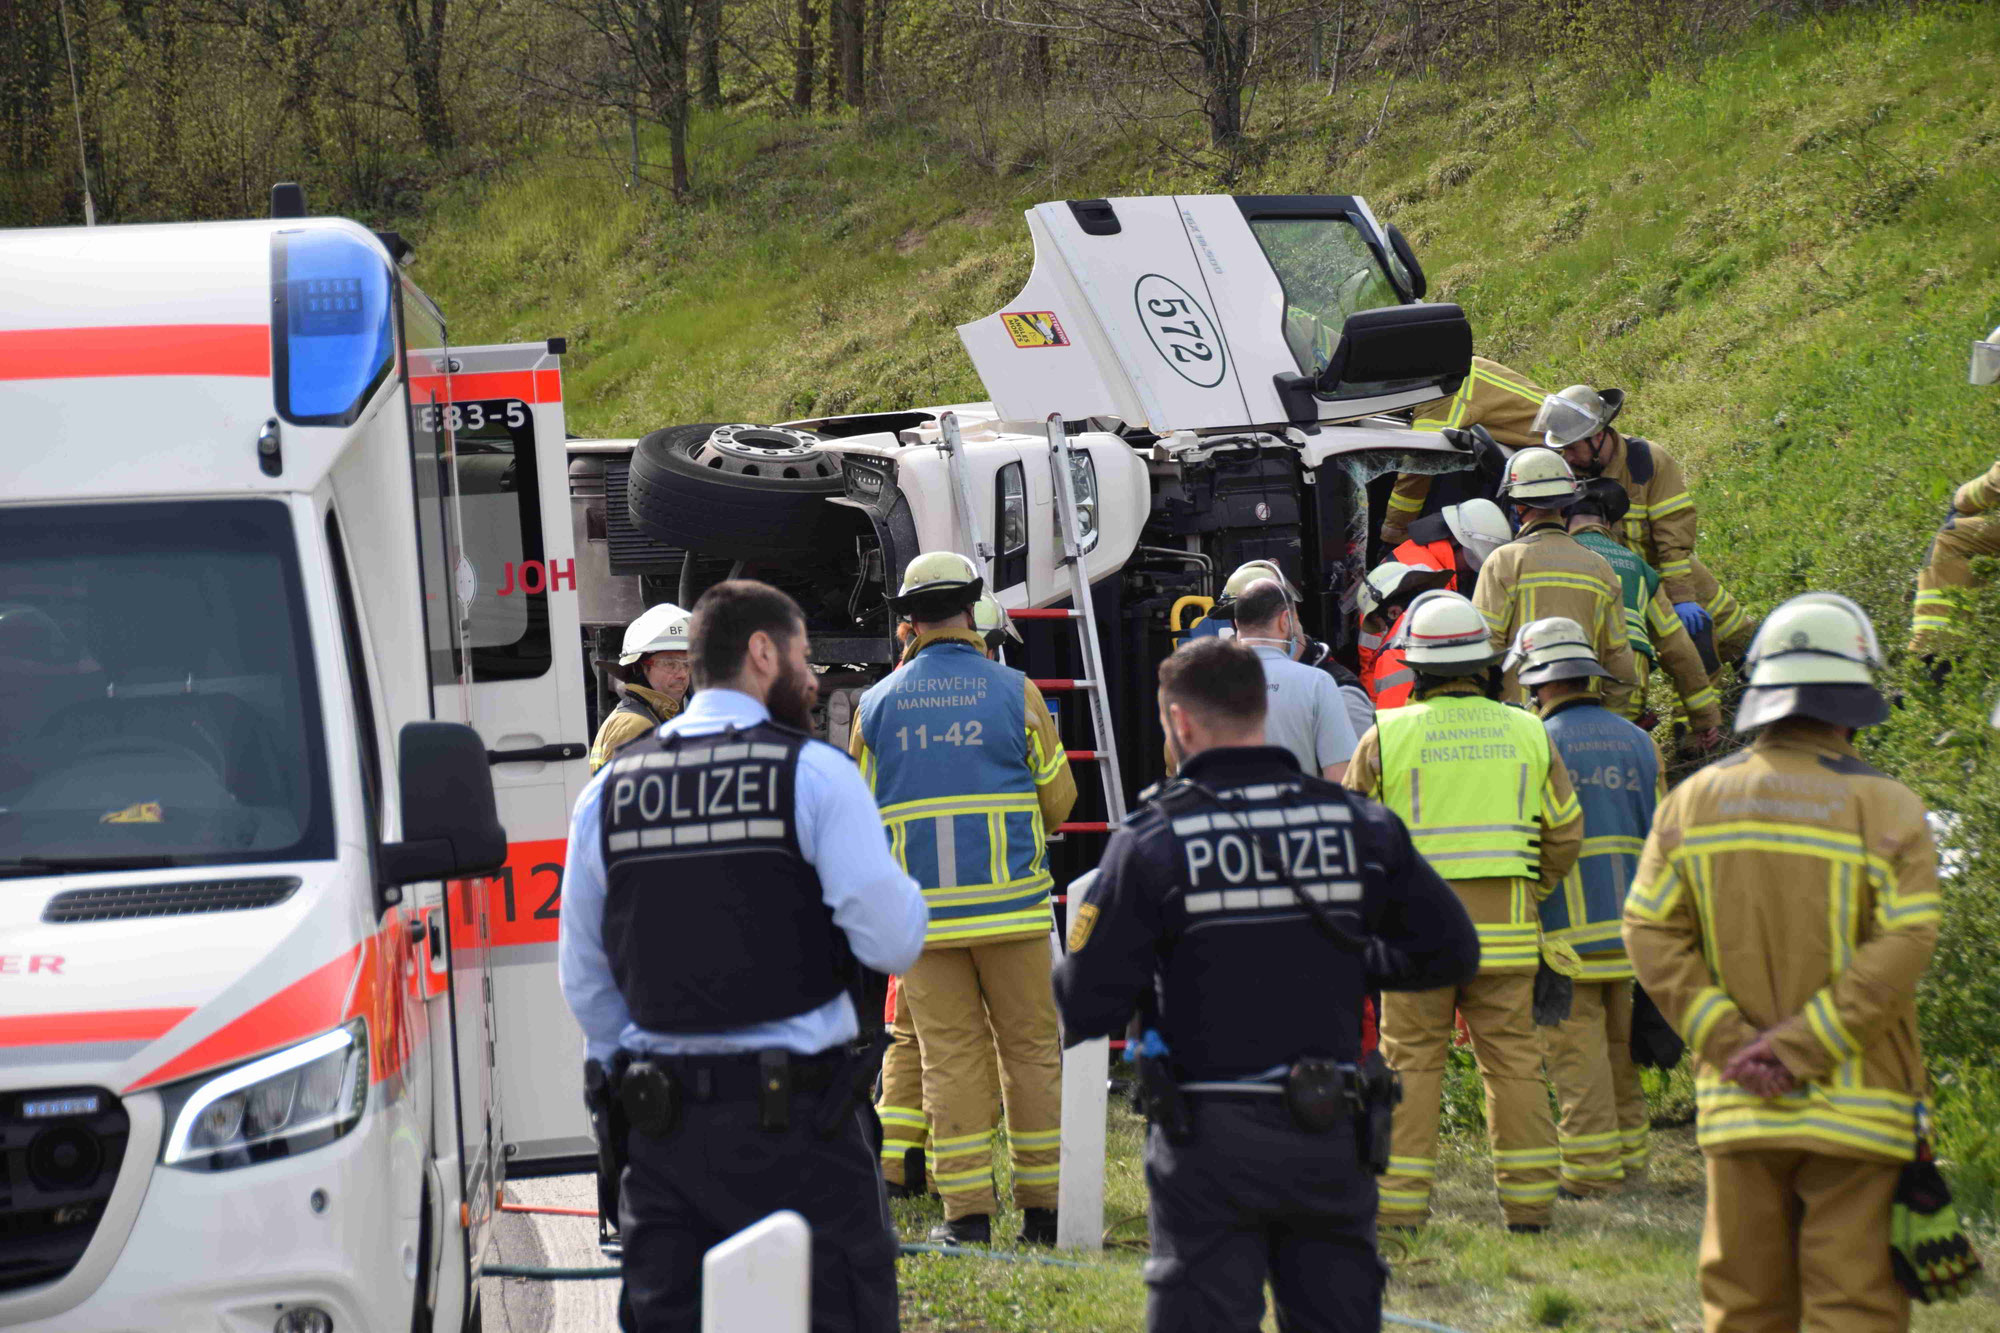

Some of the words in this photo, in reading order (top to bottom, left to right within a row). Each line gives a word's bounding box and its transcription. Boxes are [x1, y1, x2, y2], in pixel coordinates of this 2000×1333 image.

[1007, 319, 1024, 343] MORTS
[1012, 317, 1031, 343] ANGLES
[1148, 299, 1213, 363] 572
[496, 558, 577, 597] JOH
[669, 626, 684, 636] BF
[895, 676, 988, 695] FEUERWEHR
[1417, 706, 1513, 726] FEUERWEHR
[895, 720, 984, 752] 11-42
[1421, 744, 1517, 764] EINSATZLEITER
[613, 765, 778, 825] POLIZEI
[1185, 827, 1358, 887] POLIZEI
[0, 953, 65, 975] ER
